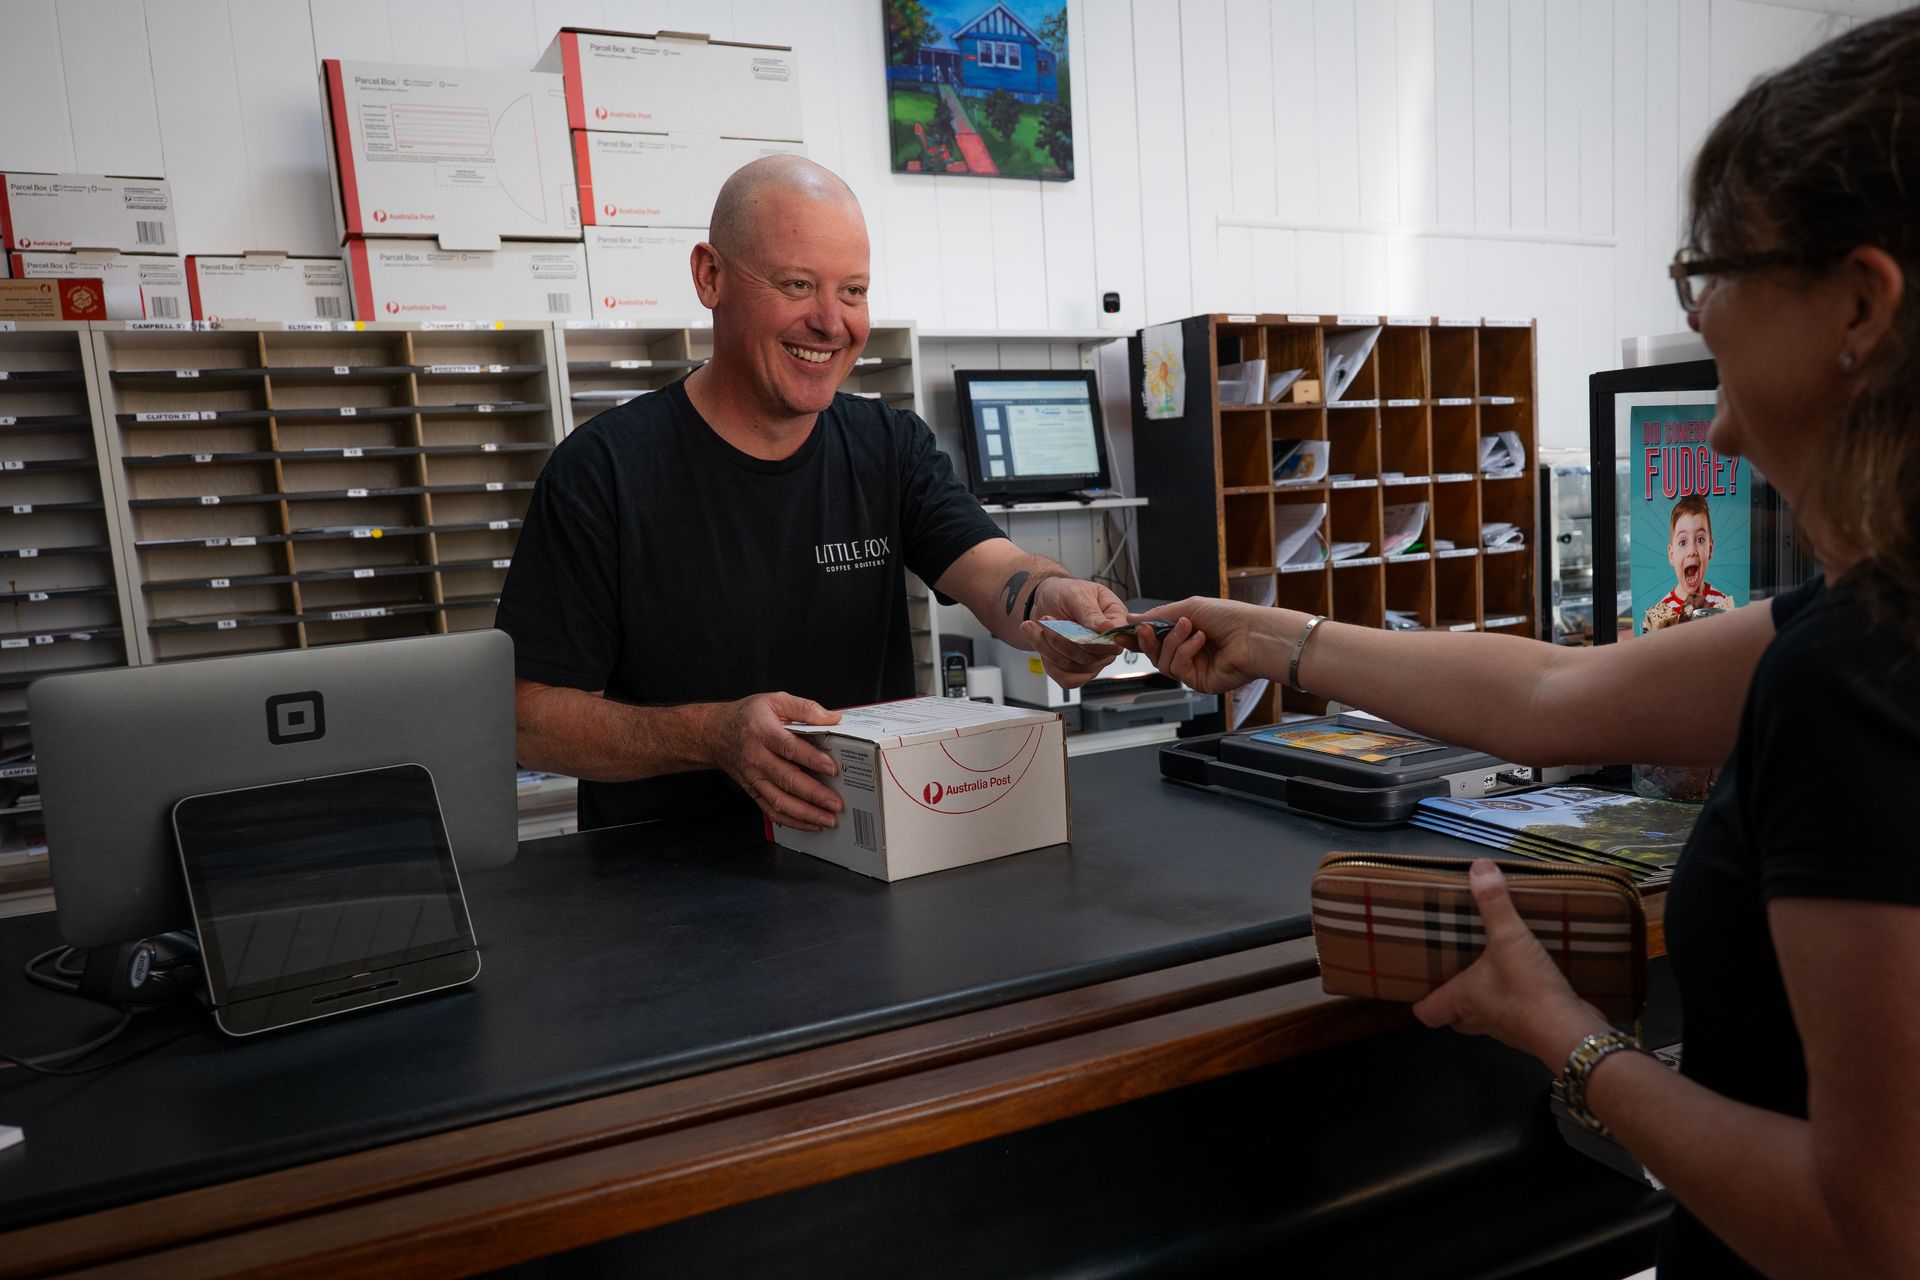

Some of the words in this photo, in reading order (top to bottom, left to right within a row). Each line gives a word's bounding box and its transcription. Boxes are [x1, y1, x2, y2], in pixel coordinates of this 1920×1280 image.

[613, 45, 625, 53] Box
[355, 76, 380, 86] Parcel
[381, 78, 396, 86] Box
[609, 111, 637, 119] Australia
[638, 112, 652, 120] Post
[11, 183, 33, 191] Parcel
[389, 212, 419, 221] Australia
[420, 213, 435, 221] Post
[379, 253, 403, 261] Parcel
[1643, 422, 1661, 445] DID
[1644, 445, 1739, 501] FUDGE?
[815, 541, 863, 564] LITTLE
[864, 537, 890, 558] FOX
[826, 564, 851, 573] COFFEE
[855, 559, 885, 569] ROASTERS
[946, 778, 988, 796] Australia
[989, 773, 1012, 788] Post
